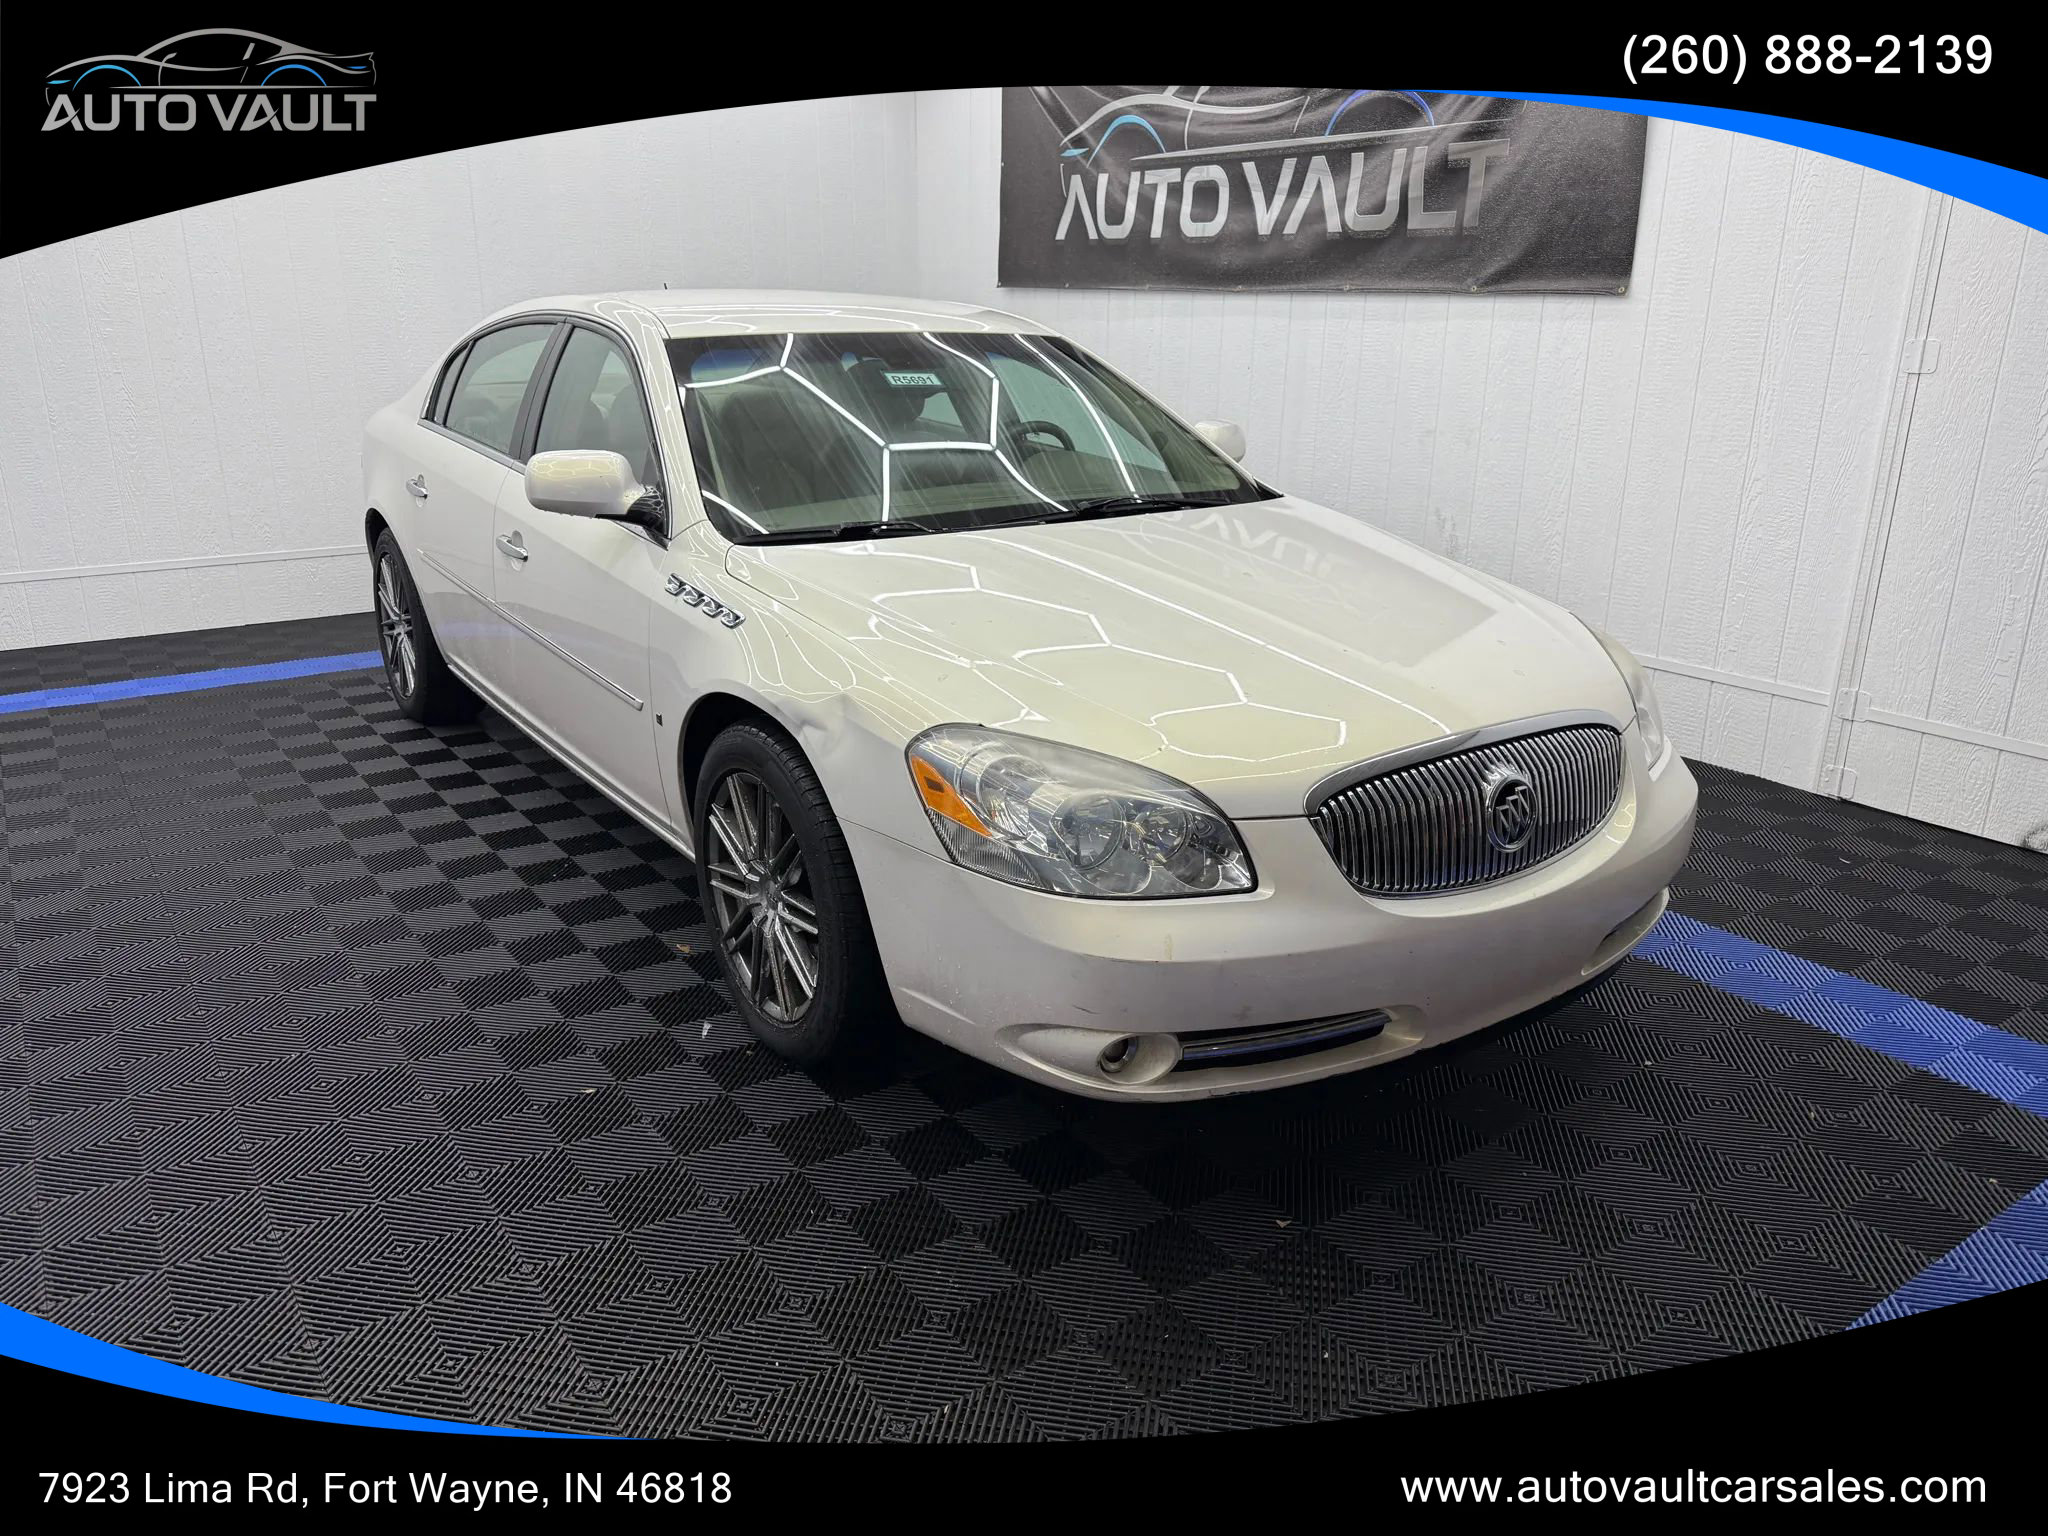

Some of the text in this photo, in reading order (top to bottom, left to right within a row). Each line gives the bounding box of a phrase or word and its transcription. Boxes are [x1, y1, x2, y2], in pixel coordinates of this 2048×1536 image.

[1055, 138, 1511, 241] AUTO VAULT
[892, 375, 935, 385] R5691
